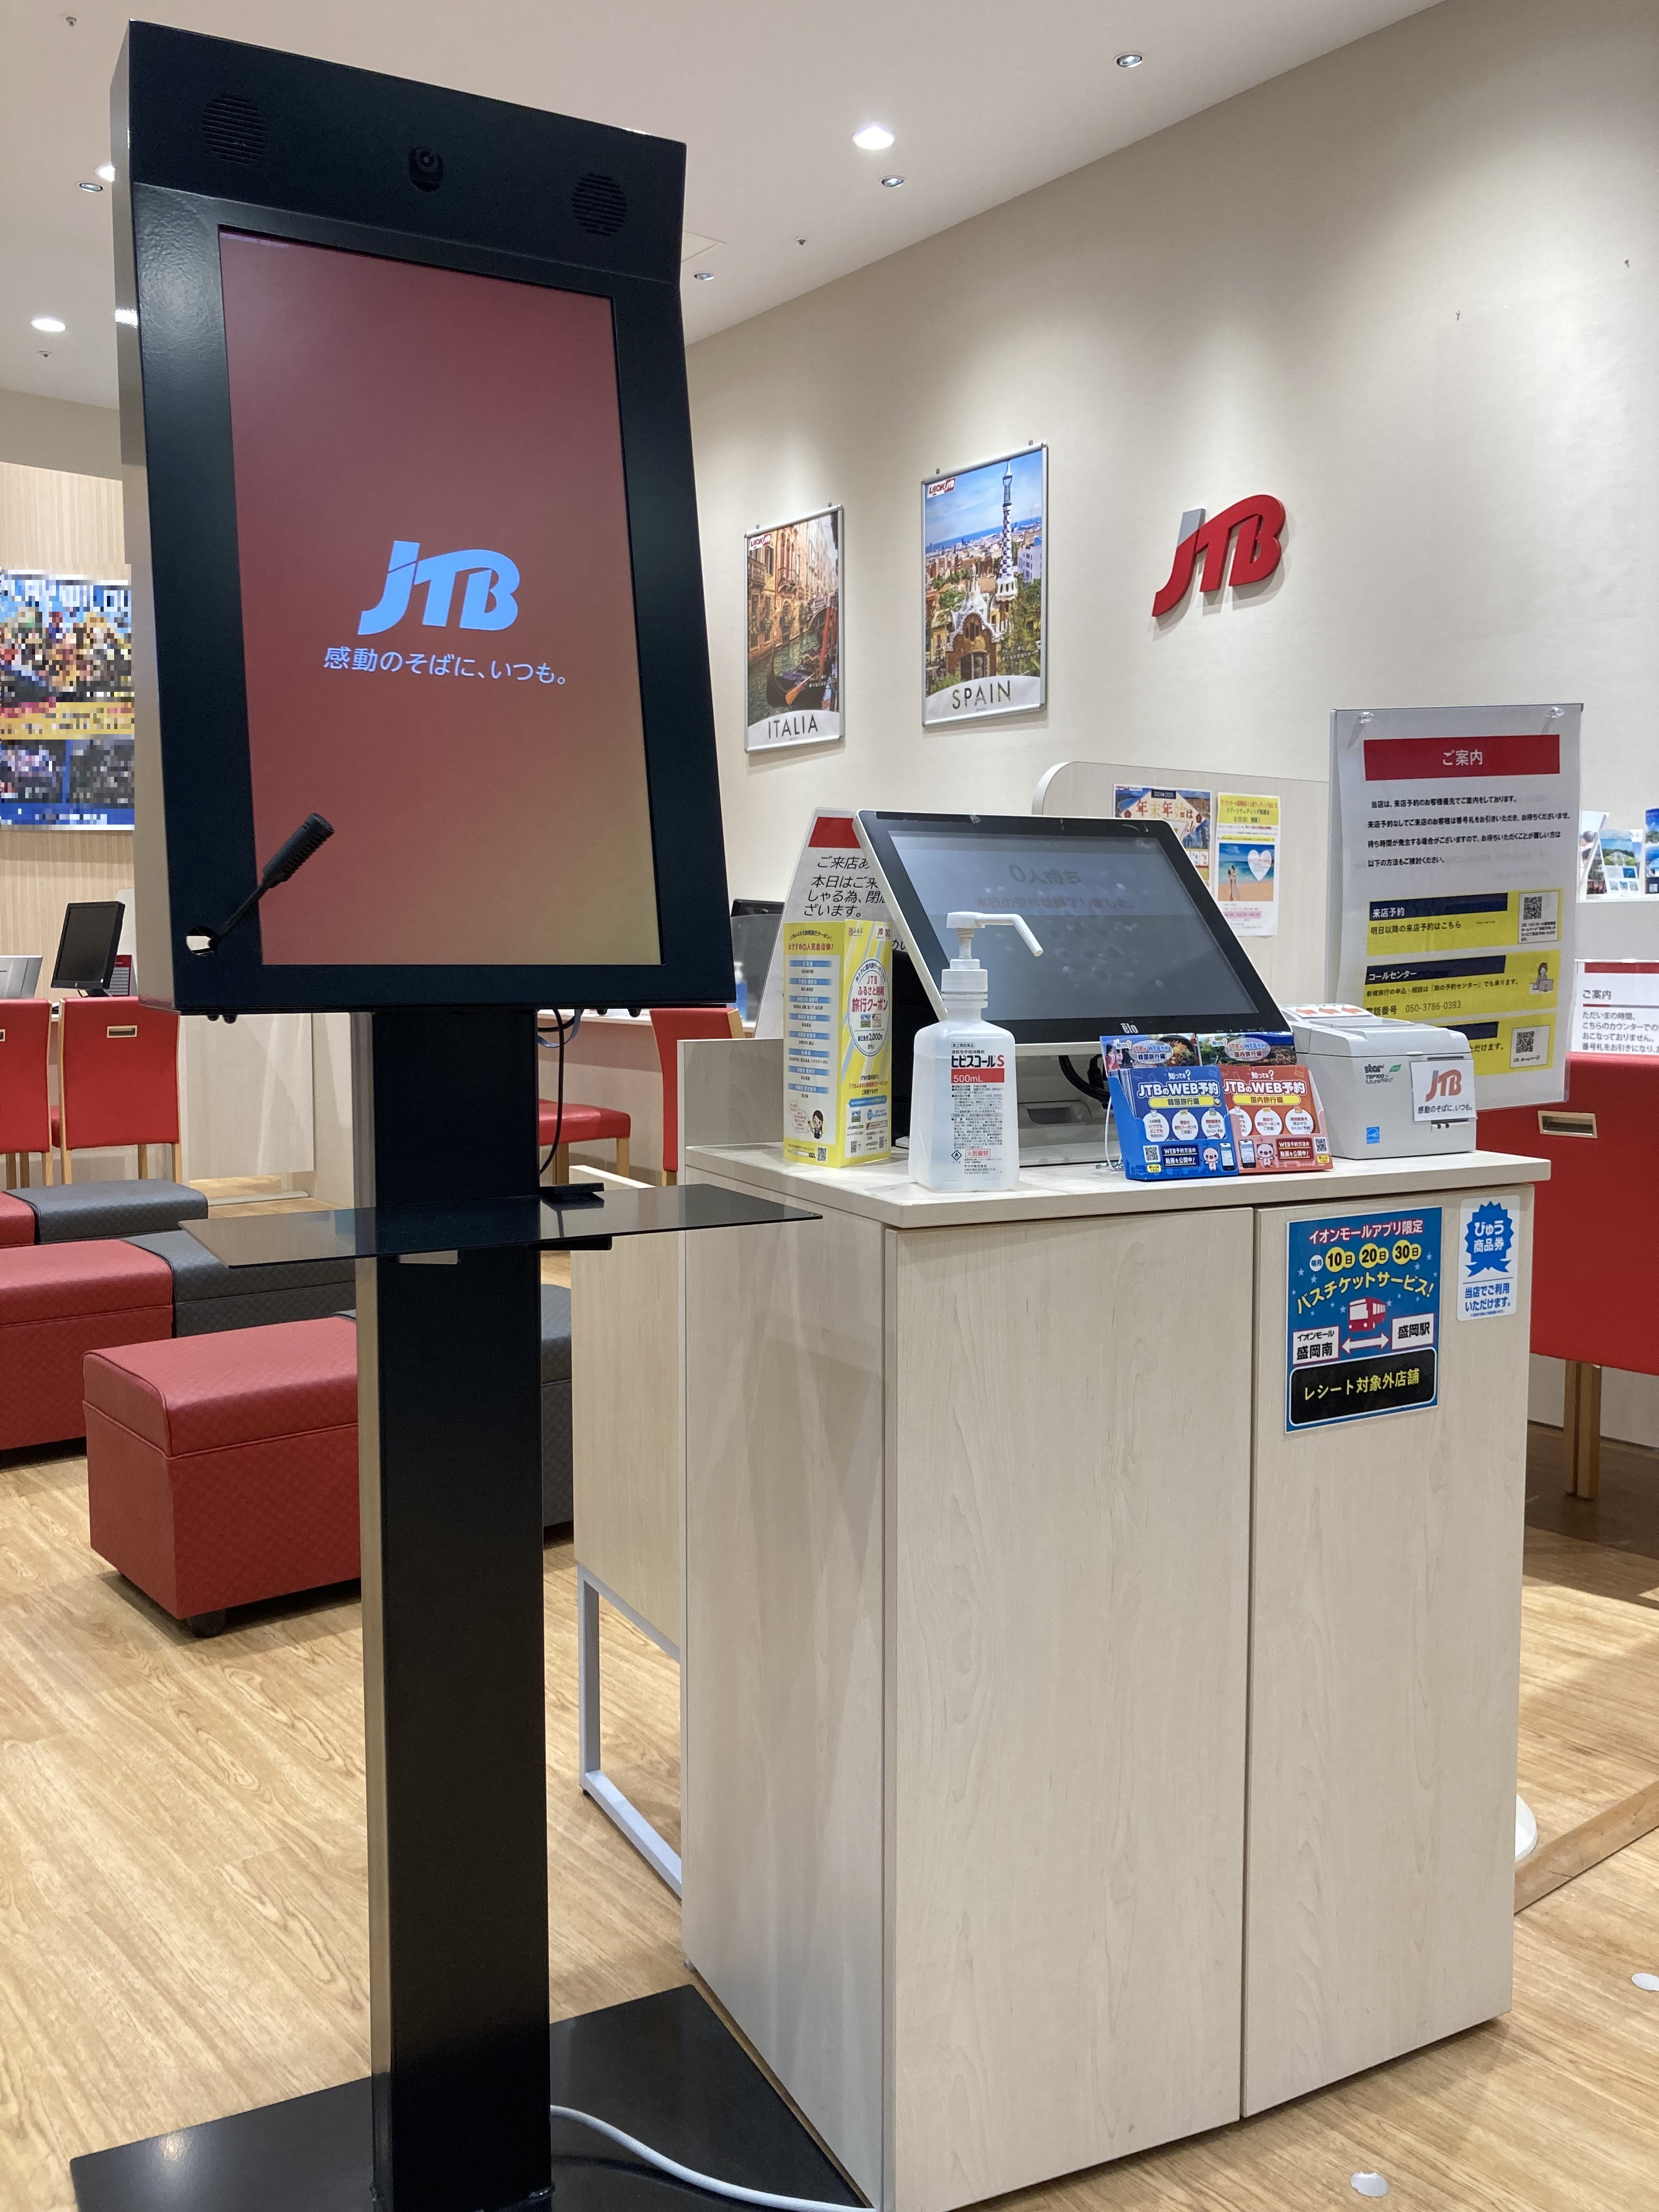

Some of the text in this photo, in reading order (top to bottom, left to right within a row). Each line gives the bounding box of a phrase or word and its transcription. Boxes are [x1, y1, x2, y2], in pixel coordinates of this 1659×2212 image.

[1152, 493, 1286, 618] JTB
[358, 540, 520, 635] JTB
[323, 646, 566, 685] 感動のそばに、いつも。
[952, 680, 1011, 710] SPAIN
[769, 715, 819, 738] ITALIA
[1442, 749, 1483, 766] ご案内
[1368, 857, 1445, 867] 以下の方法もご検討ください。
[804, 905, 861, 918] ざいます。
[1373, 907, 1405, 918] 来店予約
[1370, 921, 1462, 935] 明日以降の来店予約はこちら
[867, 975, 878, 985] JTB
[1368, 970, 1418, 981] コールセンター
[858, 986, 884, 996] ふるさと納税
[1583, 990, 1611, 1000] ご案内
[852, 997, 888, 1013] 旅行クーポン
[1406, 1001, 1462, 1013] 050-3786-0393
[1583, 1012, 1635, 1020] ただいまの時間、
[1582, 1032, 1654, 1042] おこなっておりません。
[953, 1074, 984, 1082] 500mL
[1168, 1070, 1191, 1081] 知ってる？
[1251, 1070, 1274, 1080] 知ってる？
[1138, 1081, 1219, 1097] JTBのWEB予約
[1224, 1081, 1306, 1094] JTBのWEB予約
[1425, 1069, 1462, 1103] JTB
[1418, 1104, 1473, 1114] 感動のそばに、いつも。
[1309, 1219, 1423, 1245] イオンモールアプリ限定
[1474, 1220, 1504, 1237] びゅう
[1474, 1237, 1504, 1254] 商品券
[1327, 1252, 1353, 1268] 10日
[1362, 1248, 1386, 1263] 20日
[1395, 1244, 1419, 1260] 30日
[1297, 1271, 1435, 1314] バスチケットサービス！
[1465, 1283, 1510, 1299] 当店でご利用
[1465, 1296, 1511, 1312] いただけます。
[1297, 1329, 1335, 1341] イオンモール
[1398, 1321, 1430, 1340] 盛岡駅
[1296, 1342, 1333, 1360] 盛岡南
[1304, 1368, 1420, 1401] レシート対象外店舗
